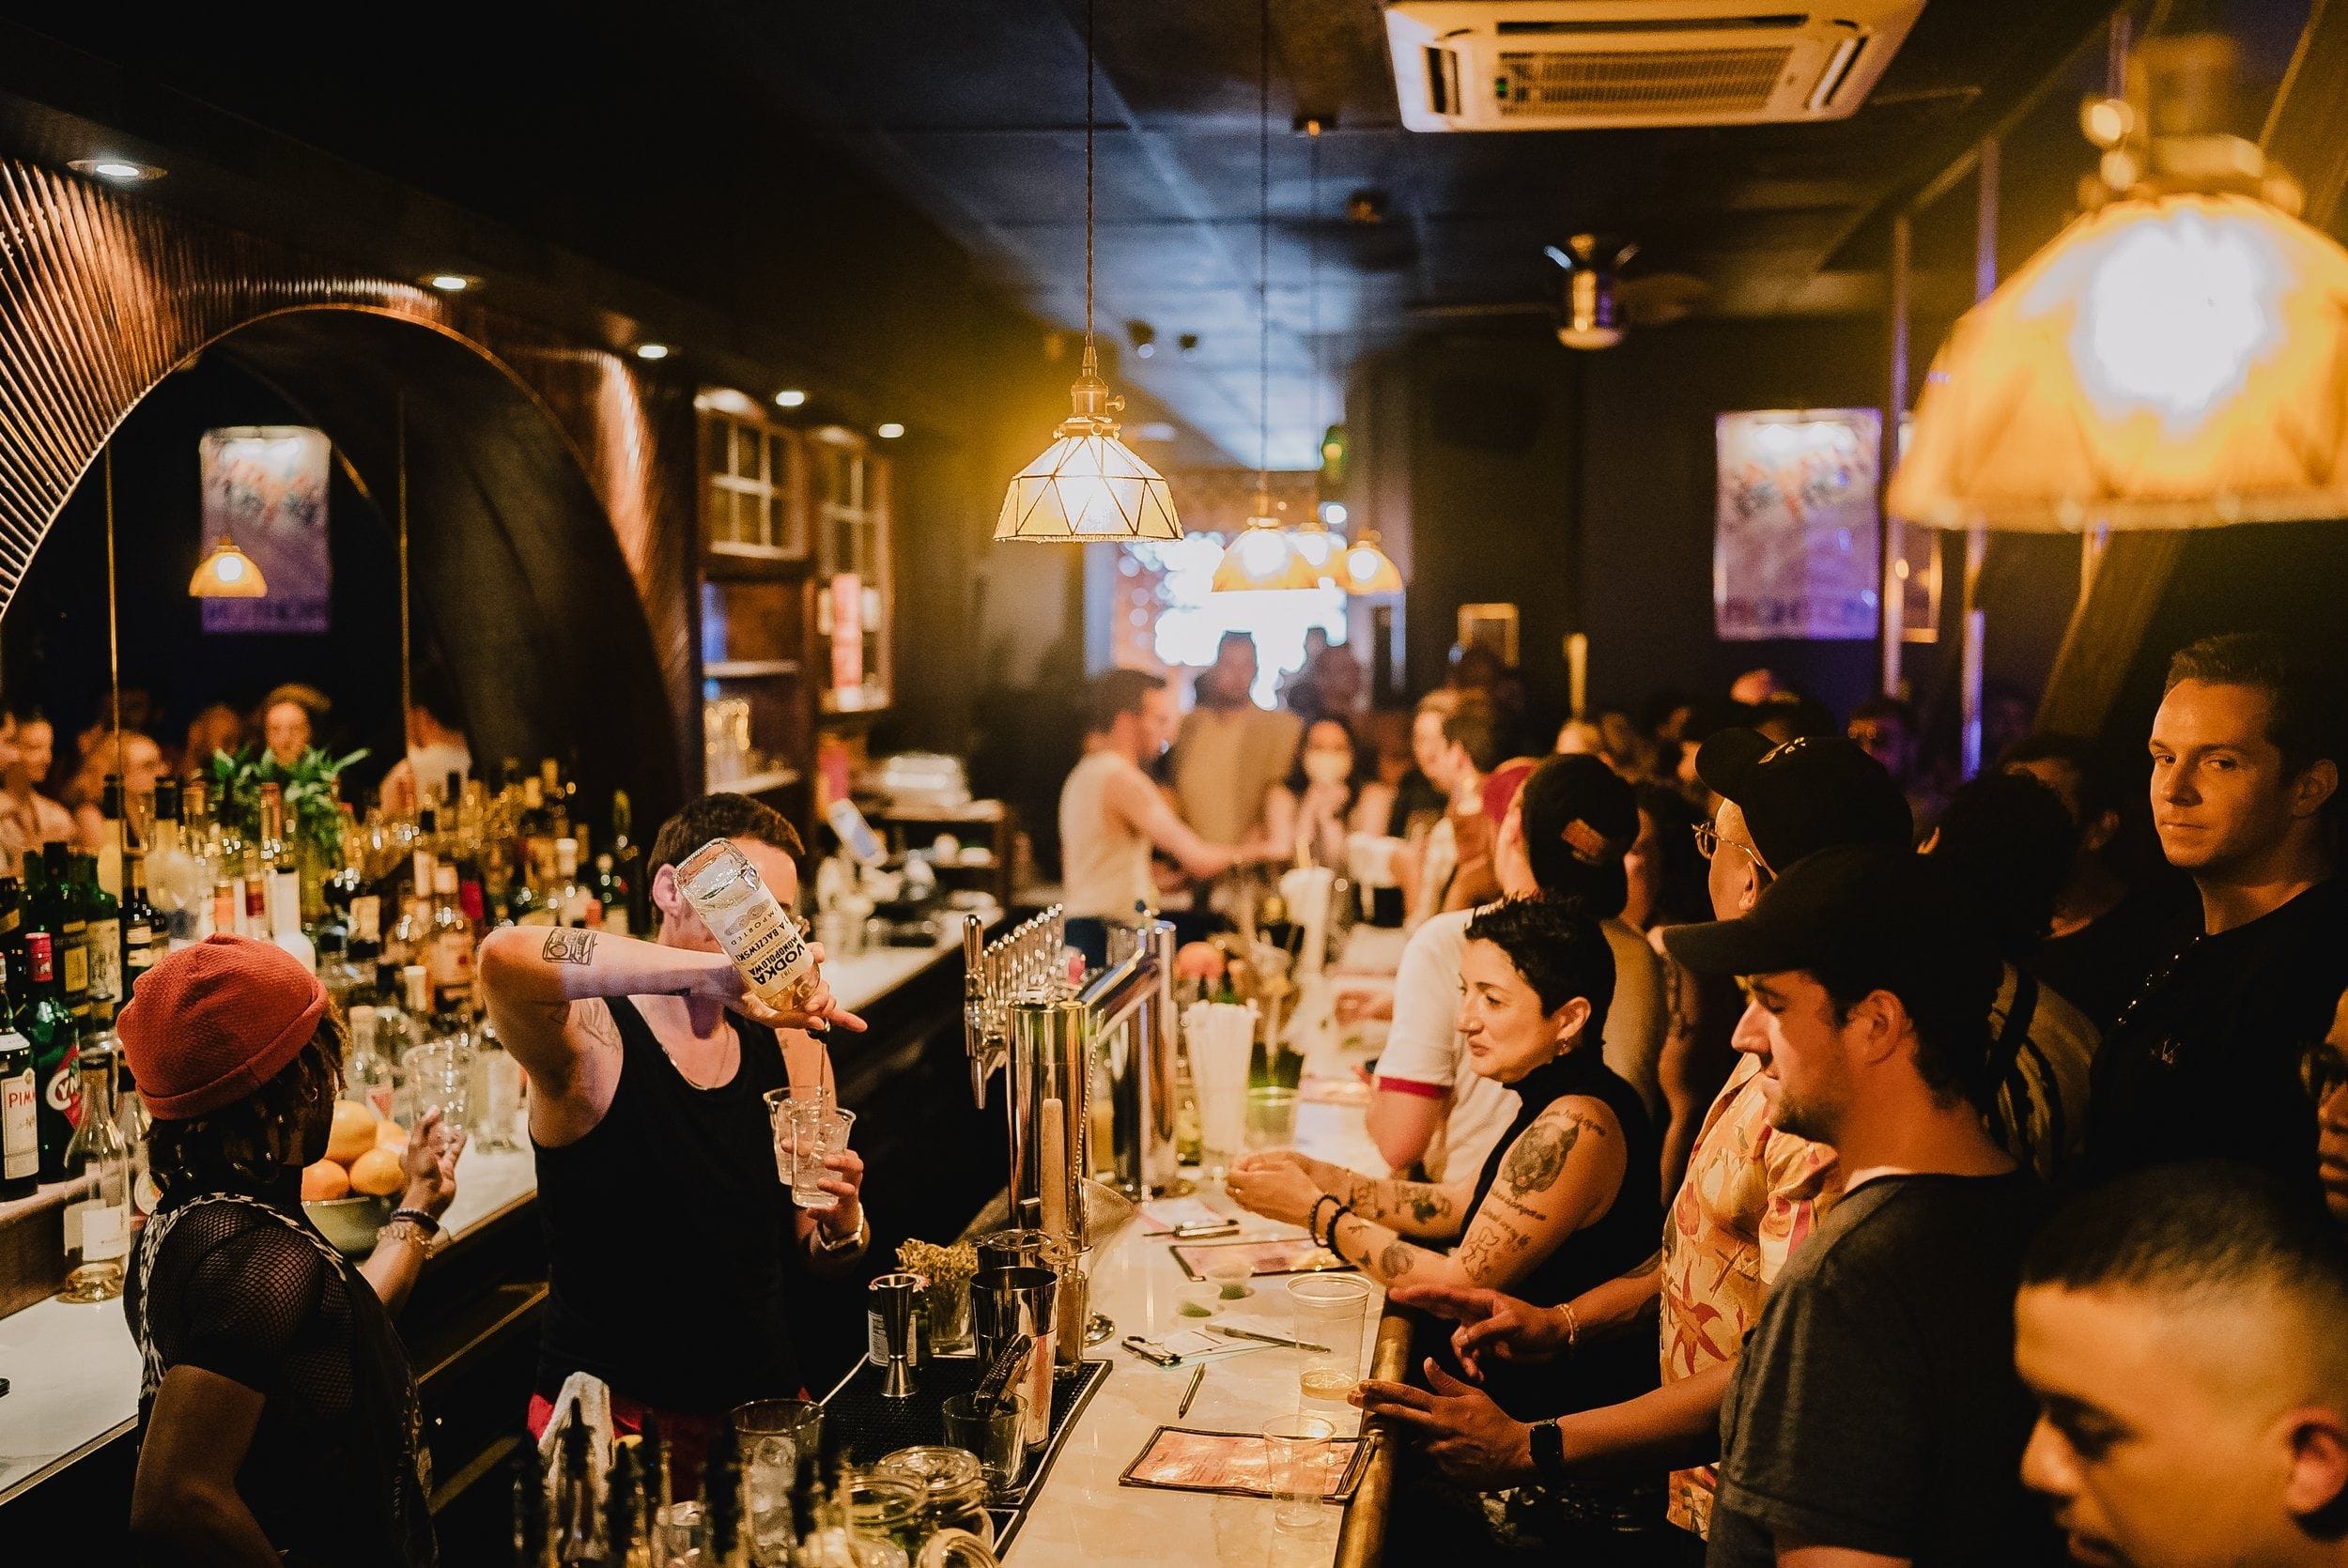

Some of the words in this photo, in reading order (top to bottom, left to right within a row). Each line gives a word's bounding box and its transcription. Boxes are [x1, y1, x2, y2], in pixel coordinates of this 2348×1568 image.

[731, 907, 778, 945] IMPORTED
[734, 929, 780, 961] BACZEWSKI
[748, 933, 798, 976] MONOPOLOWA
[753, 944, 805, 985] VODKA
[8, 1092, 36, 1108] PIM
